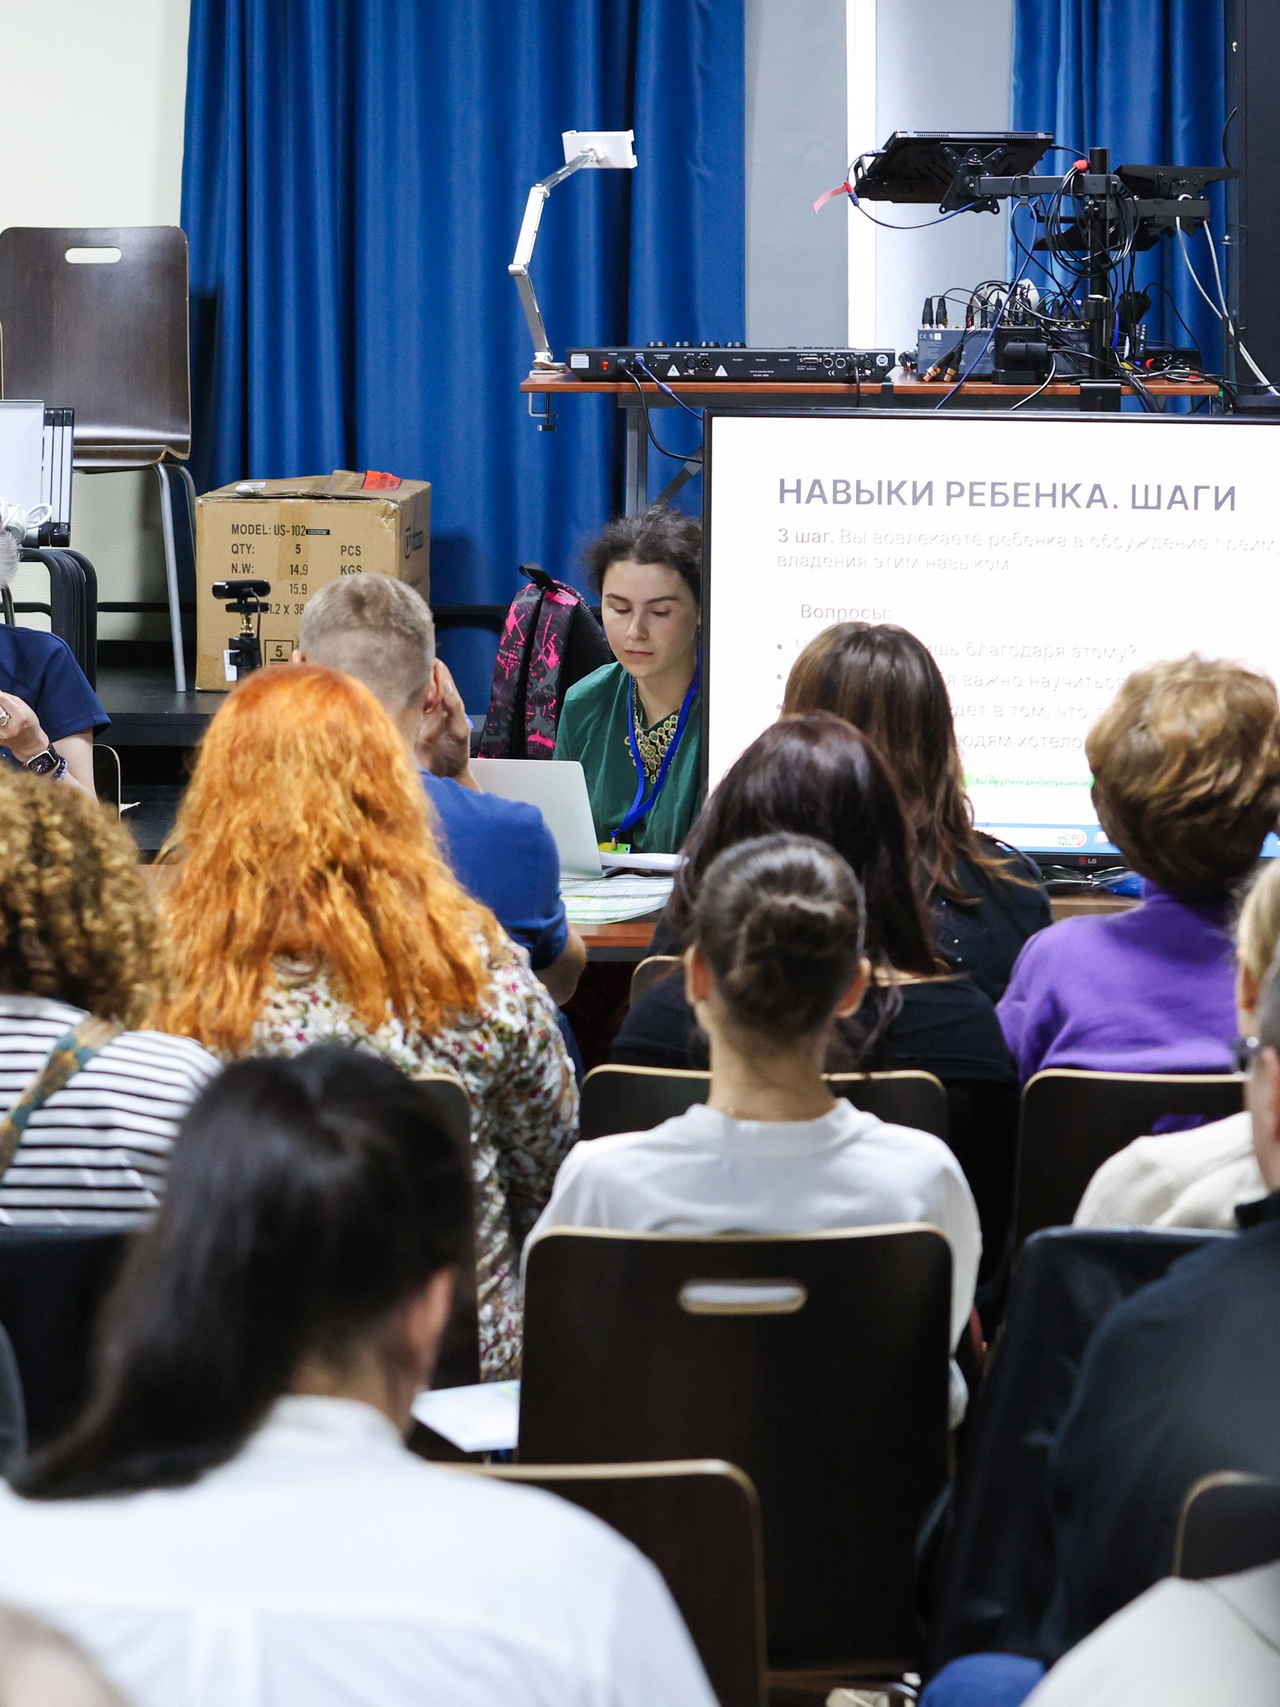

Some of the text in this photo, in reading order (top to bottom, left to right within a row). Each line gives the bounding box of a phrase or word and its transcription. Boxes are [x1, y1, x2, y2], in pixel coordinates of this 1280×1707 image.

[779, 478, 1236, 512] НАВЫКИ РЕБЕНКА. ШАГИ
[231, 523, 307, 537] MODEL: US-102
[777, 528, 789, 544] 3
[794, 531, 834, 545] шаг.
[840, 528, 866, 545] Вы
[873, 531, 983, 547] вовлекаете
[1073, 535, 1084, 549] в
[1090, 533, 1209, 553] обсуждение
[1214, 536, 1280, 556] преим
[231, 543, 362, 557] QTY: 5 PCS
[231, 562, 363, 576] N.W: 14.9 KGS
[777, 554, 1015, 573] владения этим навыком.
[289, 583, 308, 595] 15.9
[263, 603, 281, 615] 1.2
[800, 603, 893, 622] Вопросы:
[275, 645, 283, 658] 5
[966, 641, 1065, 662] благодаря
[1072, 644, 1138, 664] этому?
[963, 674, 1023, 689] важно
[954, 703, 987, 719] дет
[993, 705, 1003, 718] в
[1012, 705, 1050, 721] том,
[1057, 707, 1088, 719] что
[958, 735, 1084, 751] юдям хотело
